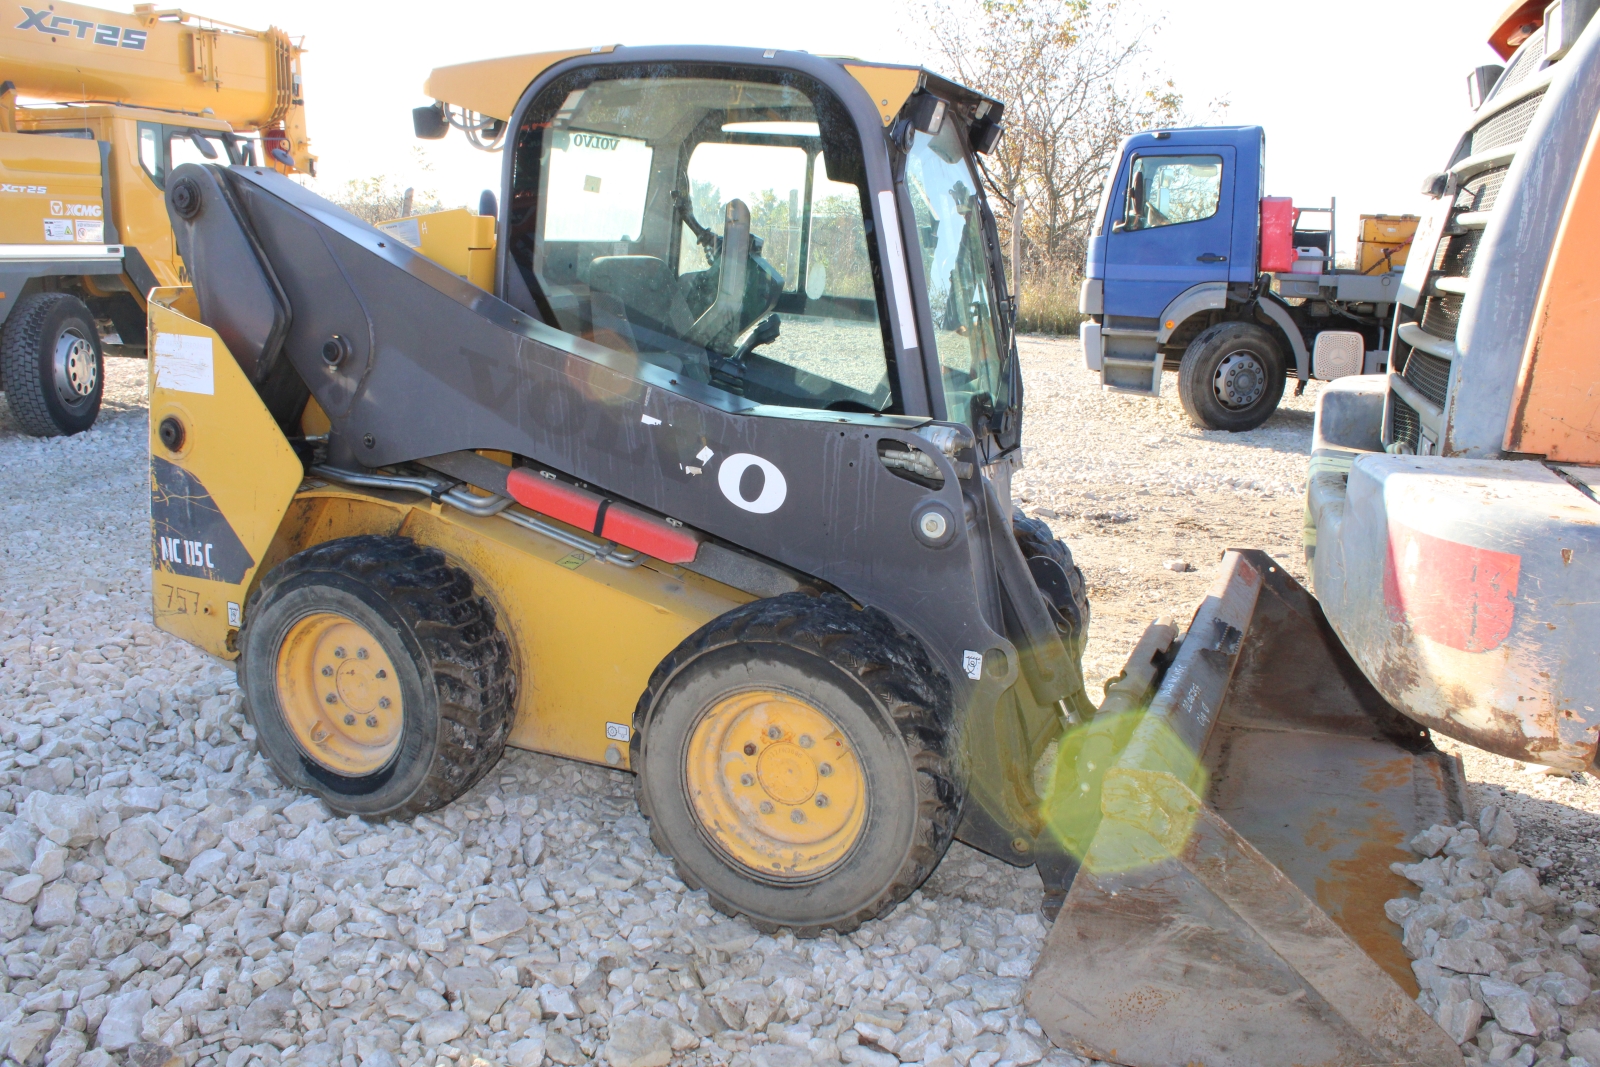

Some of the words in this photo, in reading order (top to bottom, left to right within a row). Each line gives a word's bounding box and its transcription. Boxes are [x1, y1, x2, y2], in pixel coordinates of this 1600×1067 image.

[14, 5, 148, 51] XCT25
[0, 183, 47, 195] XCT25
[65, 203, 102, 218] XCMG
